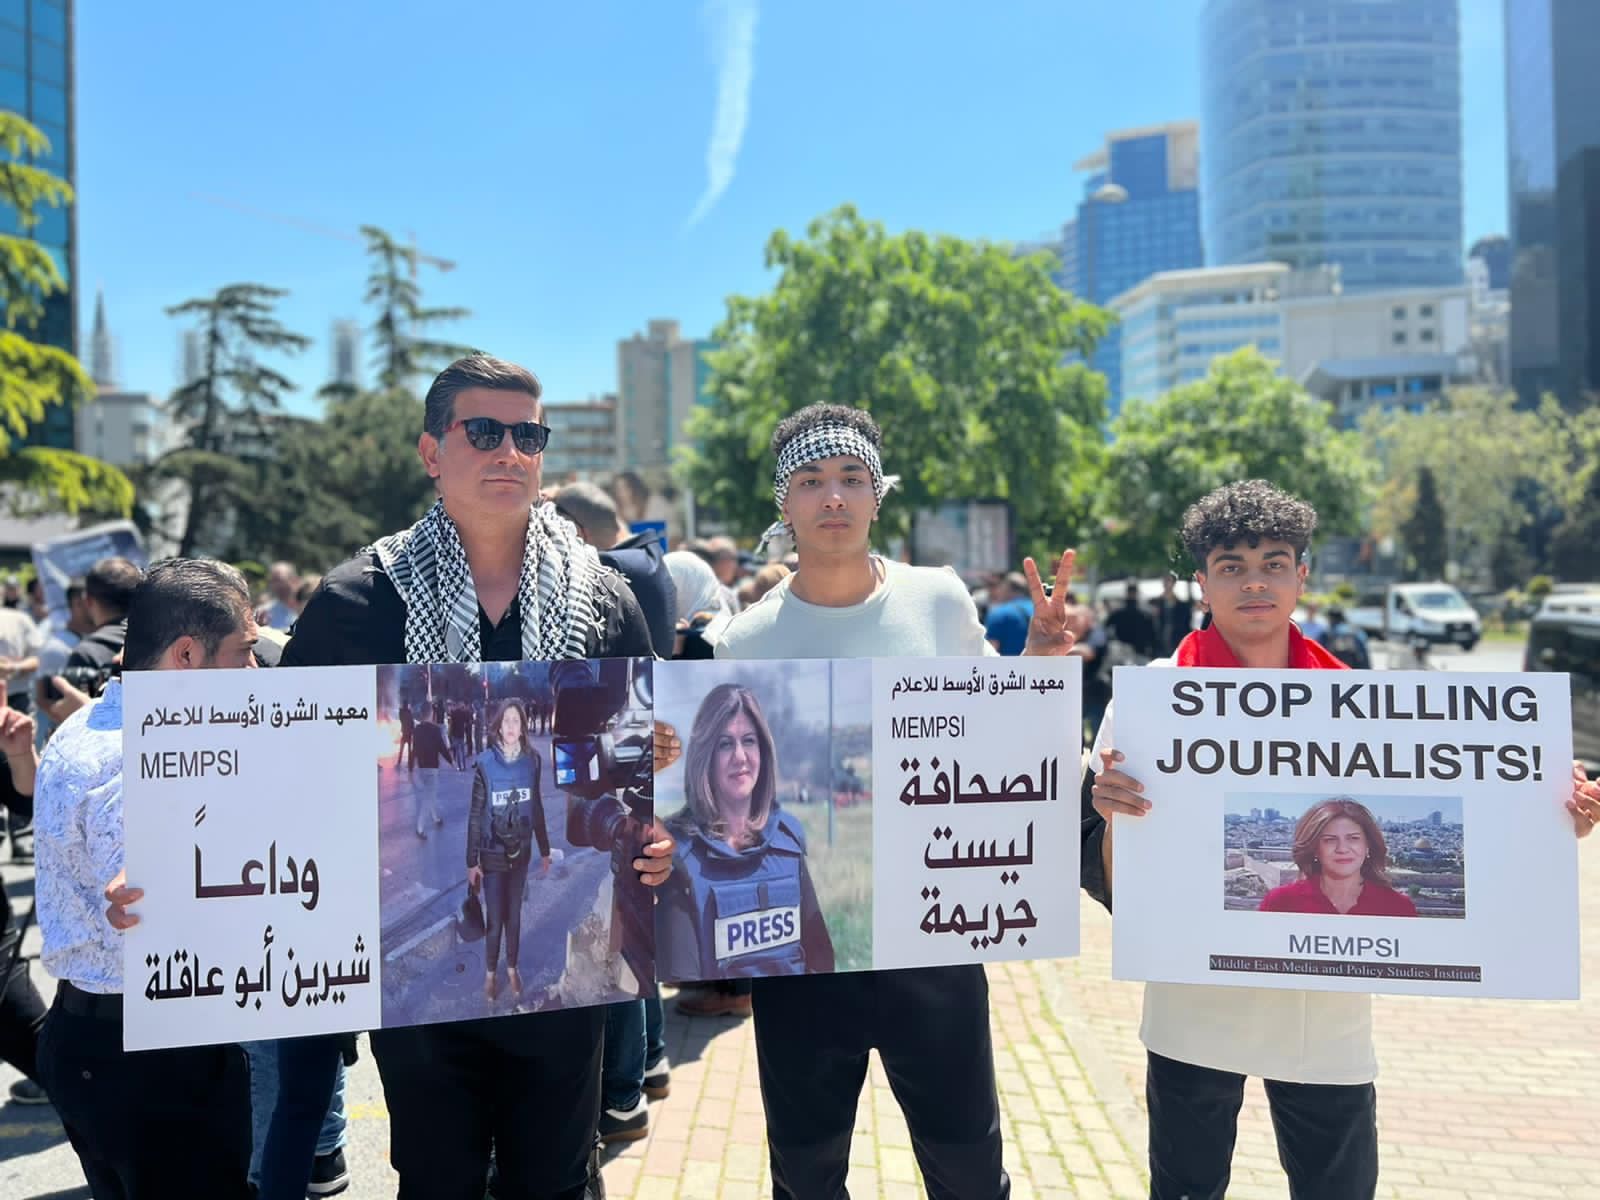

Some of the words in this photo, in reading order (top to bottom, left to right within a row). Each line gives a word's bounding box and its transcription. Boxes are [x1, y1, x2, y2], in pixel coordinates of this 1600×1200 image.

[891, 675, 938, 701] للاعلام
[942, 666, 985, 696] الأوسط
[988, 670, 1026, 696] الشرق
[1029, 677, 1065, 694] معهد
[208, 693, 265, 730] الأوسط
[270, 697, 318, 729] الشرق
[324, 704, 369, 726] معهد
[1171, 680, 1313, 718] STOP
[1331, 683, 1538, 722] KILLING
[140, 706, 203, 737] للاعلام
[891, 715, 966, 739] MEMPSI
[140, 749, 239, 779] MEMPSI
[1156, 738, 1543, 782] JOURNALISTS!
[496, 790, 527, 803] PRS
[899, 756, 1058, 806] الصحافة
[924, 820, 1034, 889] ليست
[727, 911, 794, 951] PRESS
[919, 885, 1038, 949] جريمة
[1289, 934, 1400, 958] MEMPSI
[144, 948, 226, 1002] عاقلة
[234, 924, 275, 1011] أبو
[282, 934, 371, 1008] شيرين
[1210, 957, 1251, 970] Middle
[1254, 960, 1279, 971] East
[1281, 961, 1319, 974] Media
[1322, 963, 1344, 975] and
[1347, 964, 1384, 978] Policy
[1387, 966, 1432, 979] Studies
[1434, 967, 1481, 981] Institute
